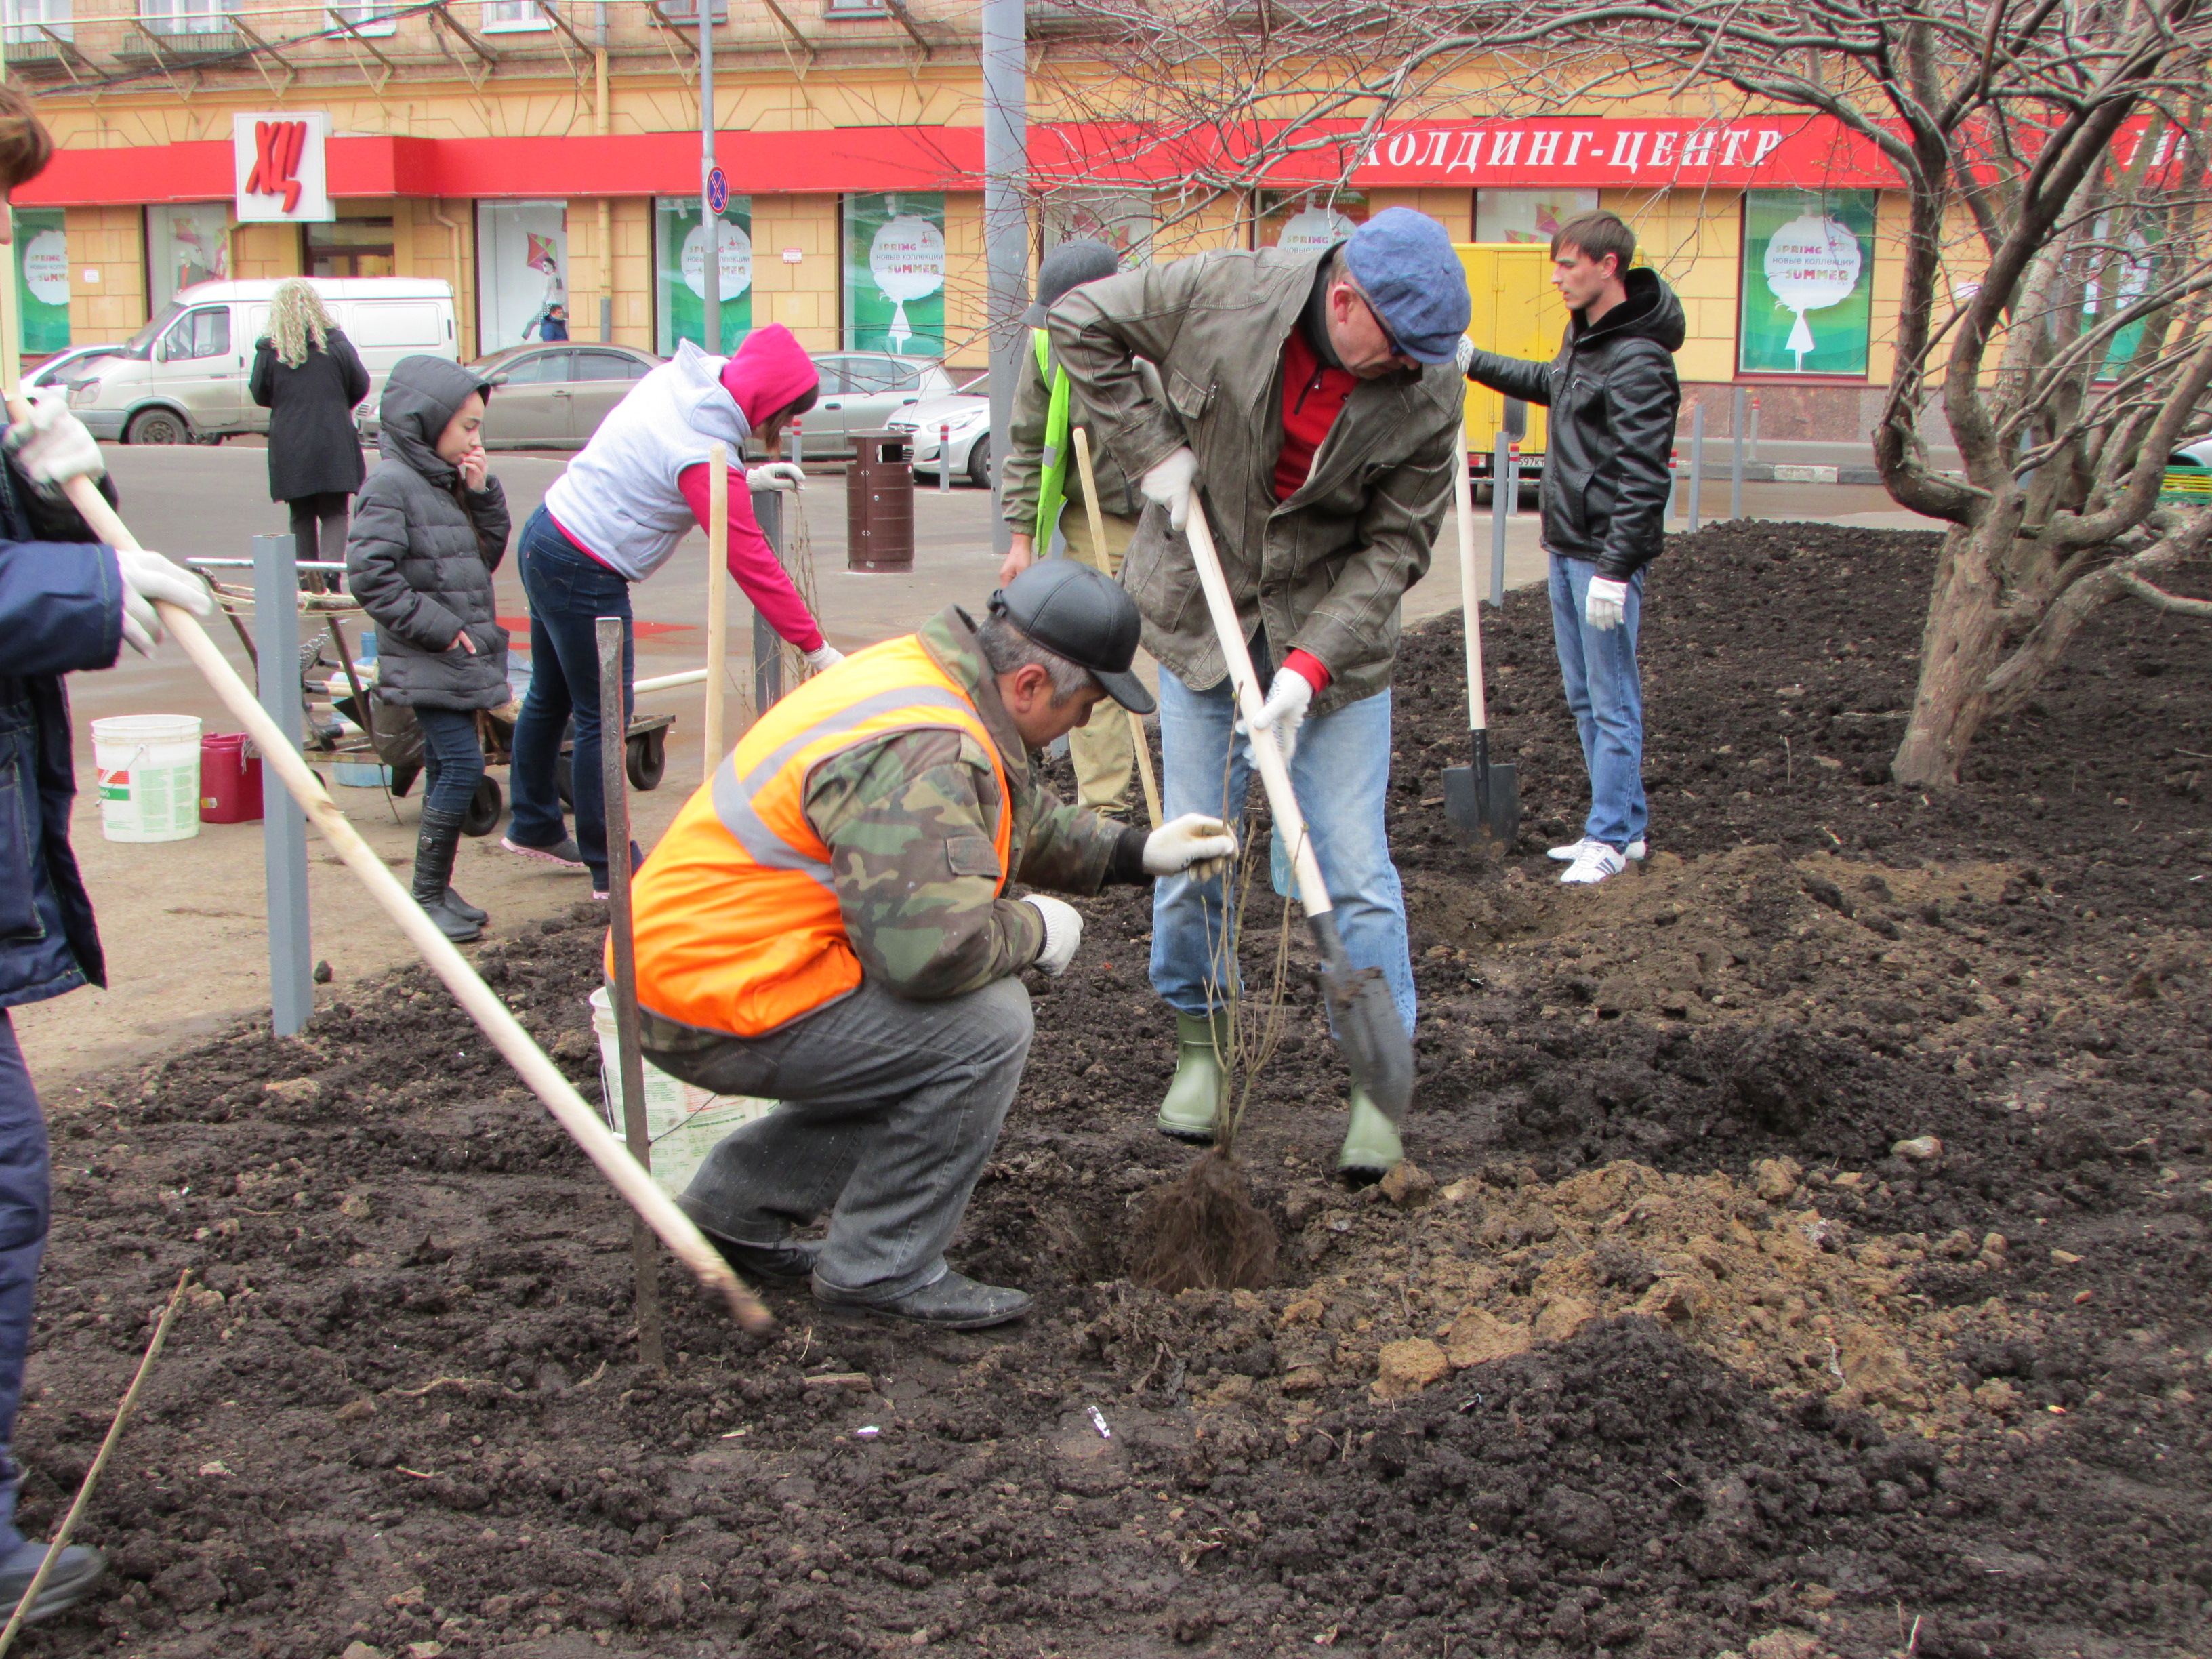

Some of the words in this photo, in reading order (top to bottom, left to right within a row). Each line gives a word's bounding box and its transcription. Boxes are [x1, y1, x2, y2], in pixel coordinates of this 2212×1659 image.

[1360, 131, 1780, 174] ХОЛДИНГ-ЦЕНТР
[1287, 236, 1328, 244] SPRING
[1776, 245, 1822, 254] SPRING
[888, 264, 939, 274] SUMMER
[39, 273, 68, 282] SUMM
[1785, 270, 1848, 281] SUMMER
